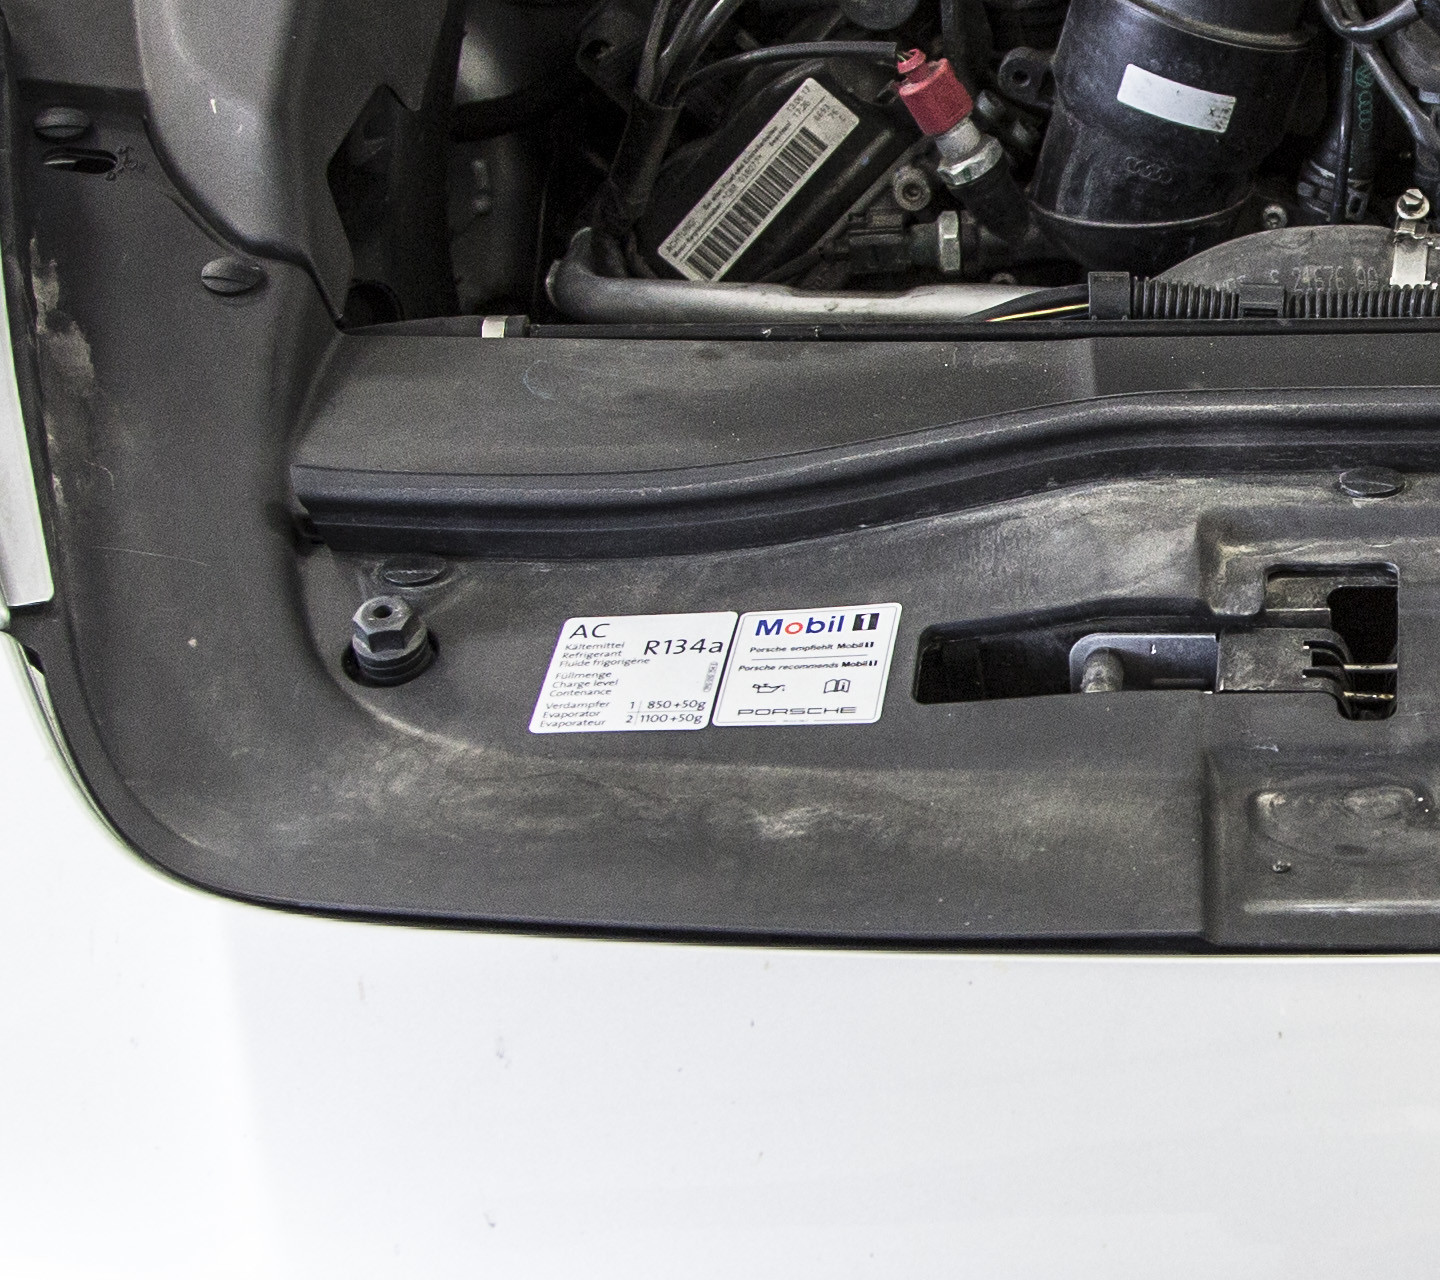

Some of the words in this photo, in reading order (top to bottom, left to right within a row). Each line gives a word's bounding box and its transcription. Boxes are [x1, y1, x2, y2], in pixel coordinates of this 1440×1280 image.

[755, 615, 845, 636] Mobil
[855, 613, 876, 632] 1
[569, 623, 610, 639] AC
[643, 638, 724, 656] R134a
[837, 641, 863, 649] Mobil
[562, 651, 622, 660] Refrigerant
[559, 659, 590, 667] Fluide
[738, 664, 776, 672] Porsche
[778, 662, 839, 670] recommends
[841, 660, 868, 668] Mobil
[552, 680, 590, 689] Charge
[593, 679, 618, 687] level
[549, 688, 612, 697] Contenance
[546, 701, 610, 711] Verdampfer
[737, 706, 858, 716] PORSCHE
[542, 710, 601, 719] Evaporator
[625, 714, 633, 723] 2
[540, 719, 606, 728] Evaporateur
